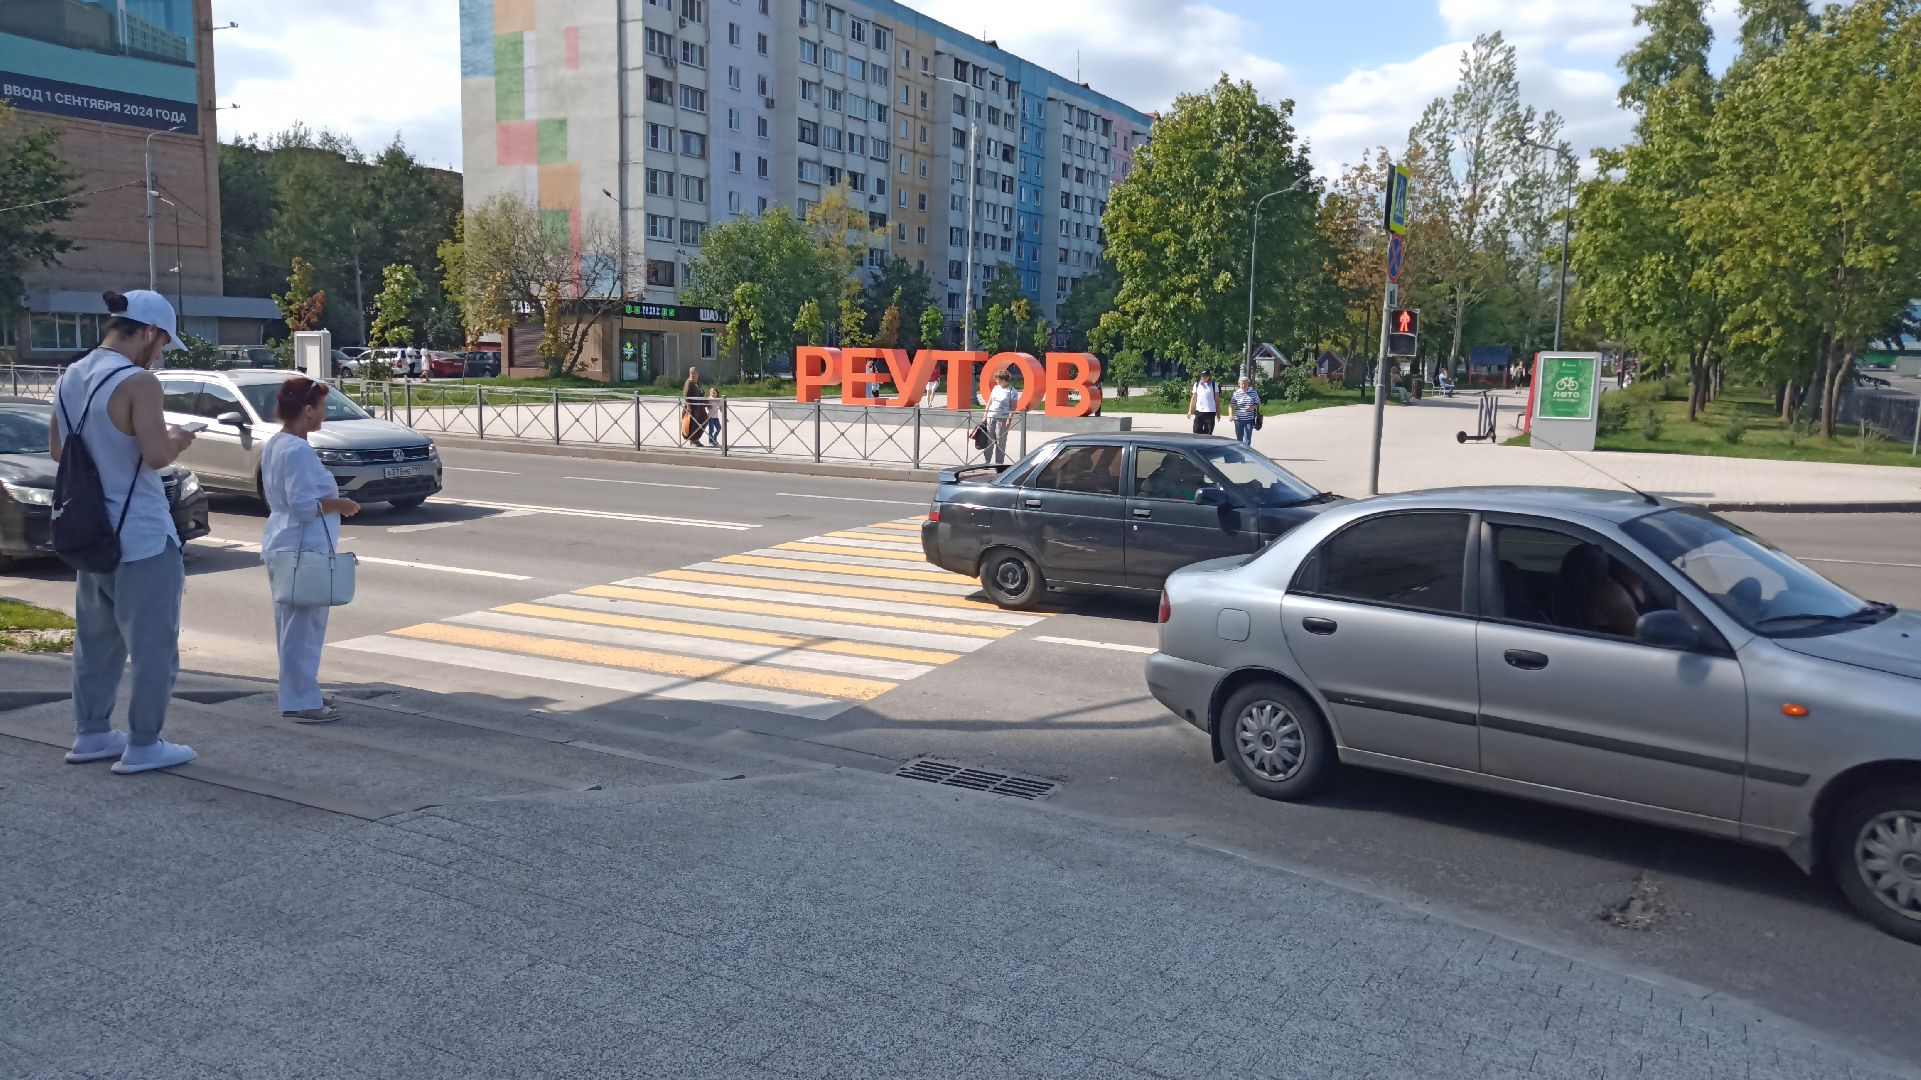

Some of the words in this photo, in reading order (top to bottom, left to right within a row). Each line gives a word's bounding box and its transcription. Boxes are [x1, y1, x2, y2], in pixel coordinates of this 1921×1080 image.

[3, 83, 43, 103] ВВОД
[45, 91, 52, 103] 1
[54, 92, 121, 113] СЕНТЯБРЯ
[123, 103, 154, 119] 2024
[155, 109, 187, 124] ГОДА
[796, 346, 1102, 417] РЕУТОВ
